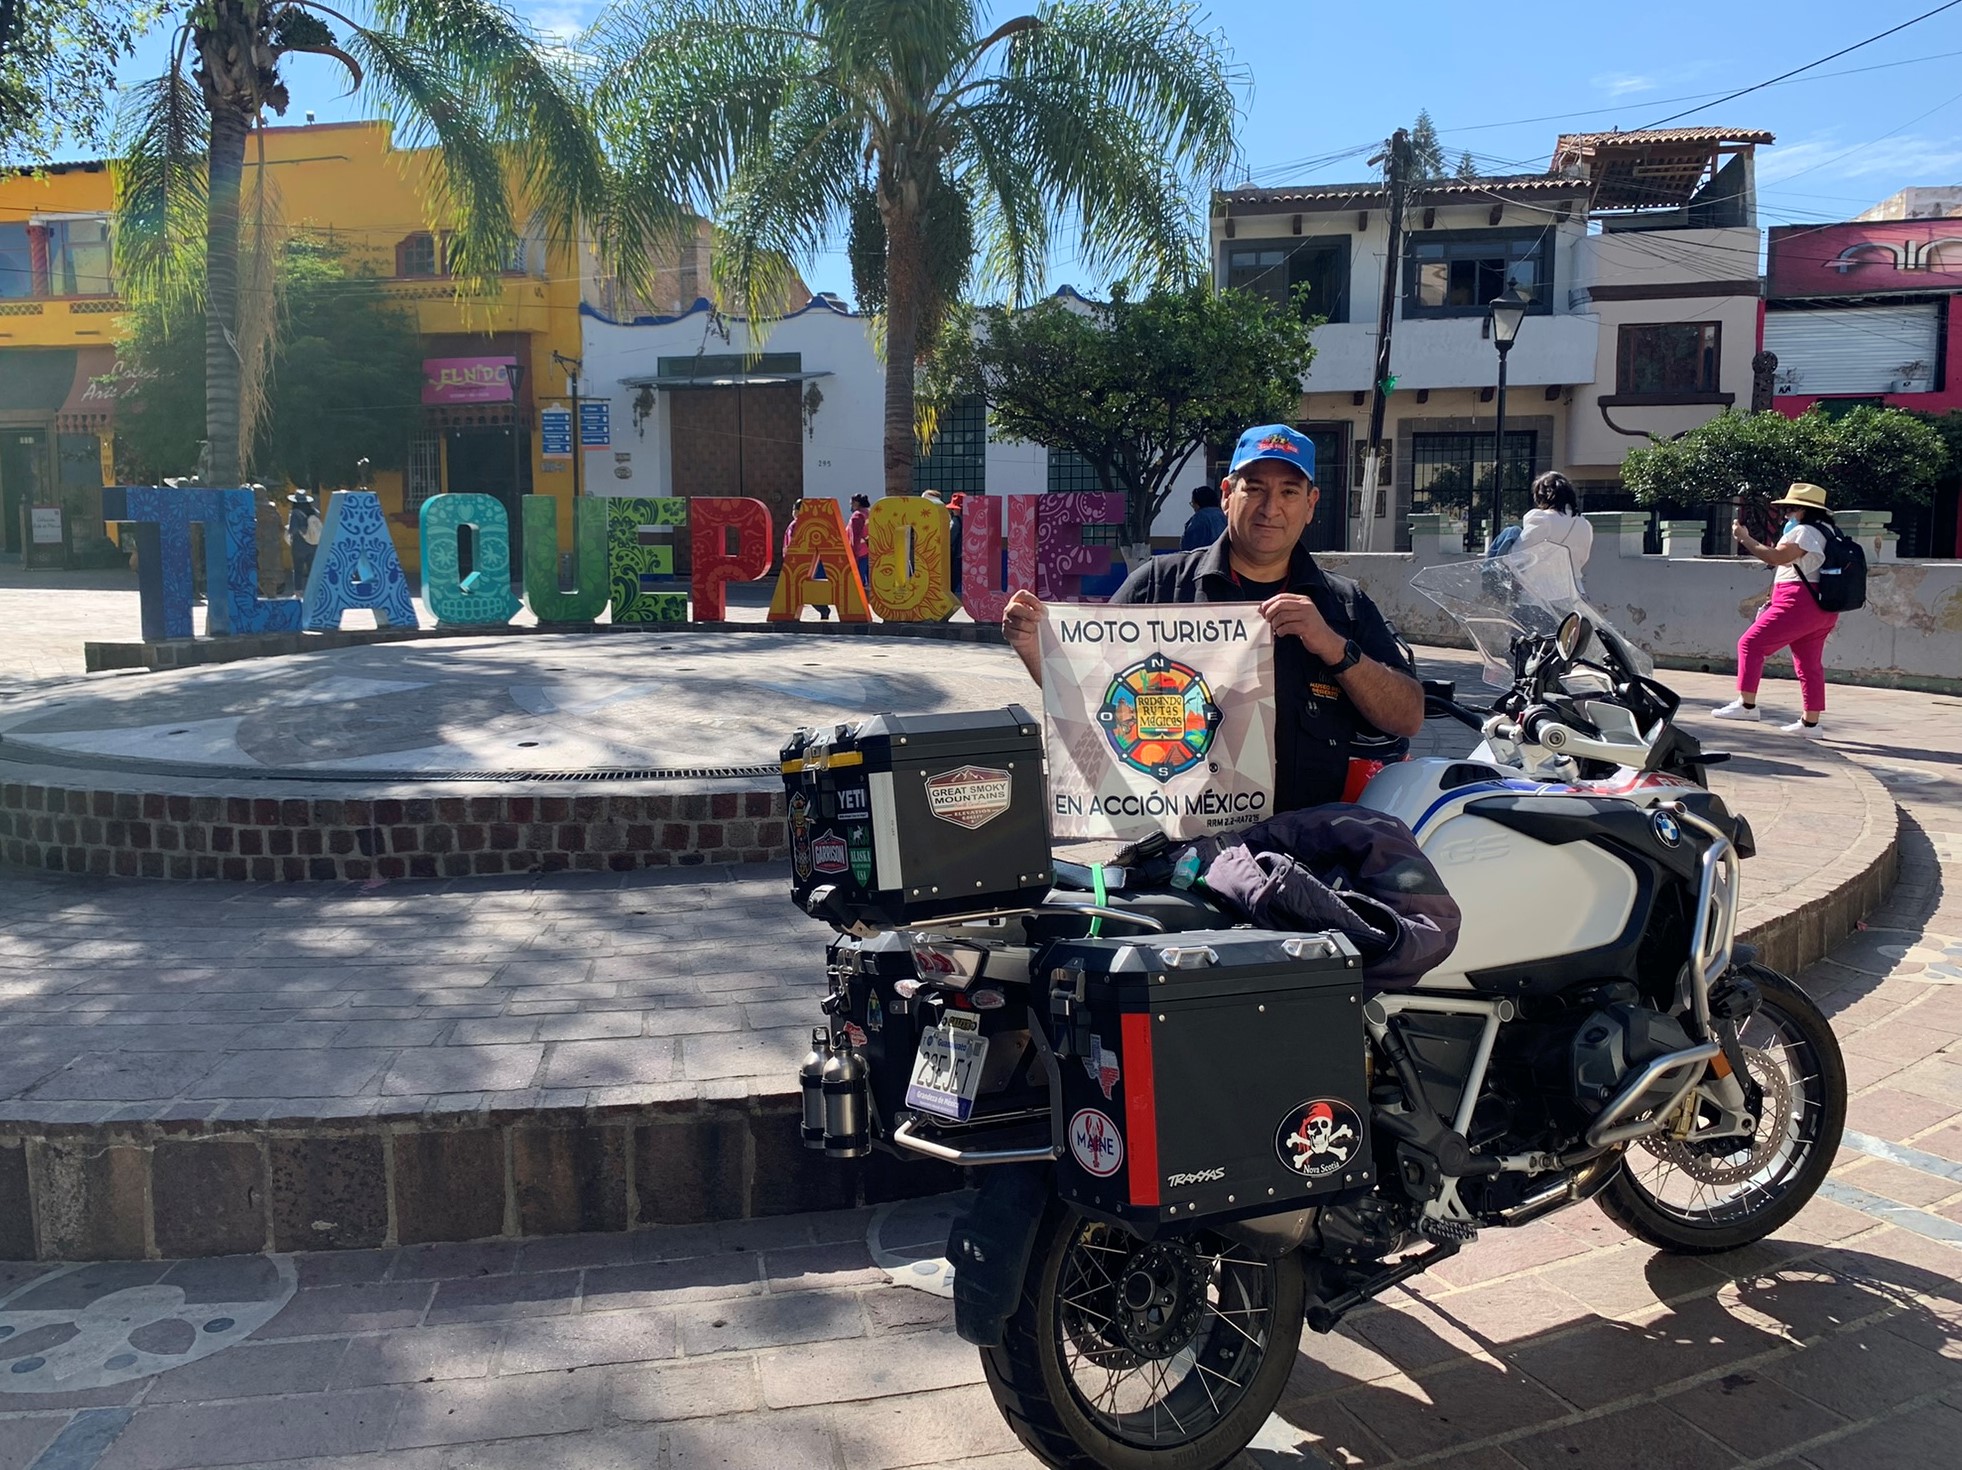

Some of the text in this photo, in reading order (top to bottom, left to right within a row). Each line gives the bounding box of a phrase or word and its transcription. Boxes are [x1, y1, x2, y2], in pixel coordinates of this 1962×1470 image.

[102, 487, 1128, 641] TLAQUEPAQUE
[1060, 619, 1248, 643] MOTO TURISTA
[1151, 659, 1164, 668] N
[1100, 712, 1113, 721] O
[1207, 712, 1218, 721] E
[1158, 767, 1169, 776] S
[932, 783, 1006, 798] GREAT SMOKY
[838, 788, 866, 809] YETI
[935, 791, 1006, 804] MOUNTAINS
[1055, 788, 1266, 816] EN ACCIÓN MÉXICO
[954, 808, 991, 817] ELEVATION
[850, 850, 872, 862] ALASKA
[1303, 1160, 1340, 1174] Nova Scotia
[1168, 1166, 1226, 1188] TRAXXAS
